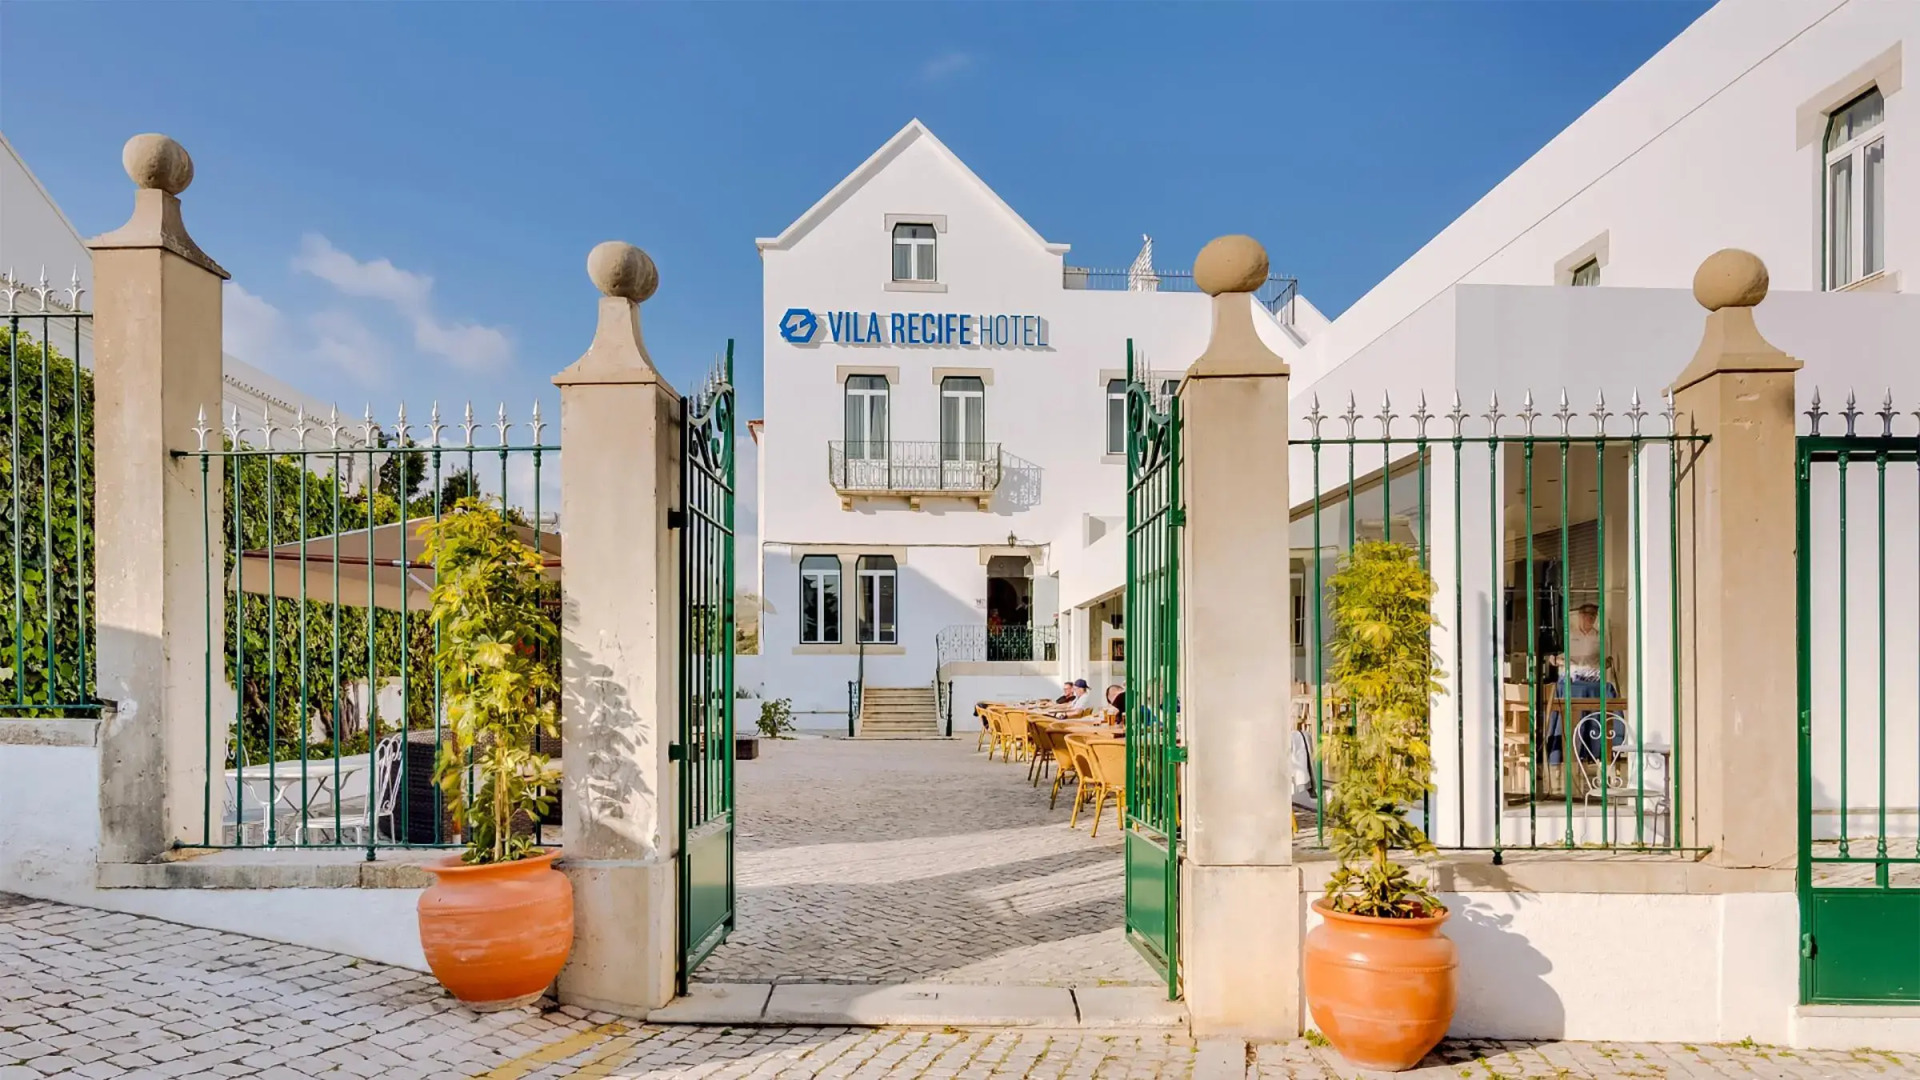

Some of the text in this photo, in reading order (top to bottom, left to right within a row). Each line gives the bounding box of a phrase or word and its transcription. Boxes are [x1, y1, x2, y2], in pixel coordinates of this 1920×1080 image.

[828, 311, 1048, 346] VILA RECIFE HOTEL
